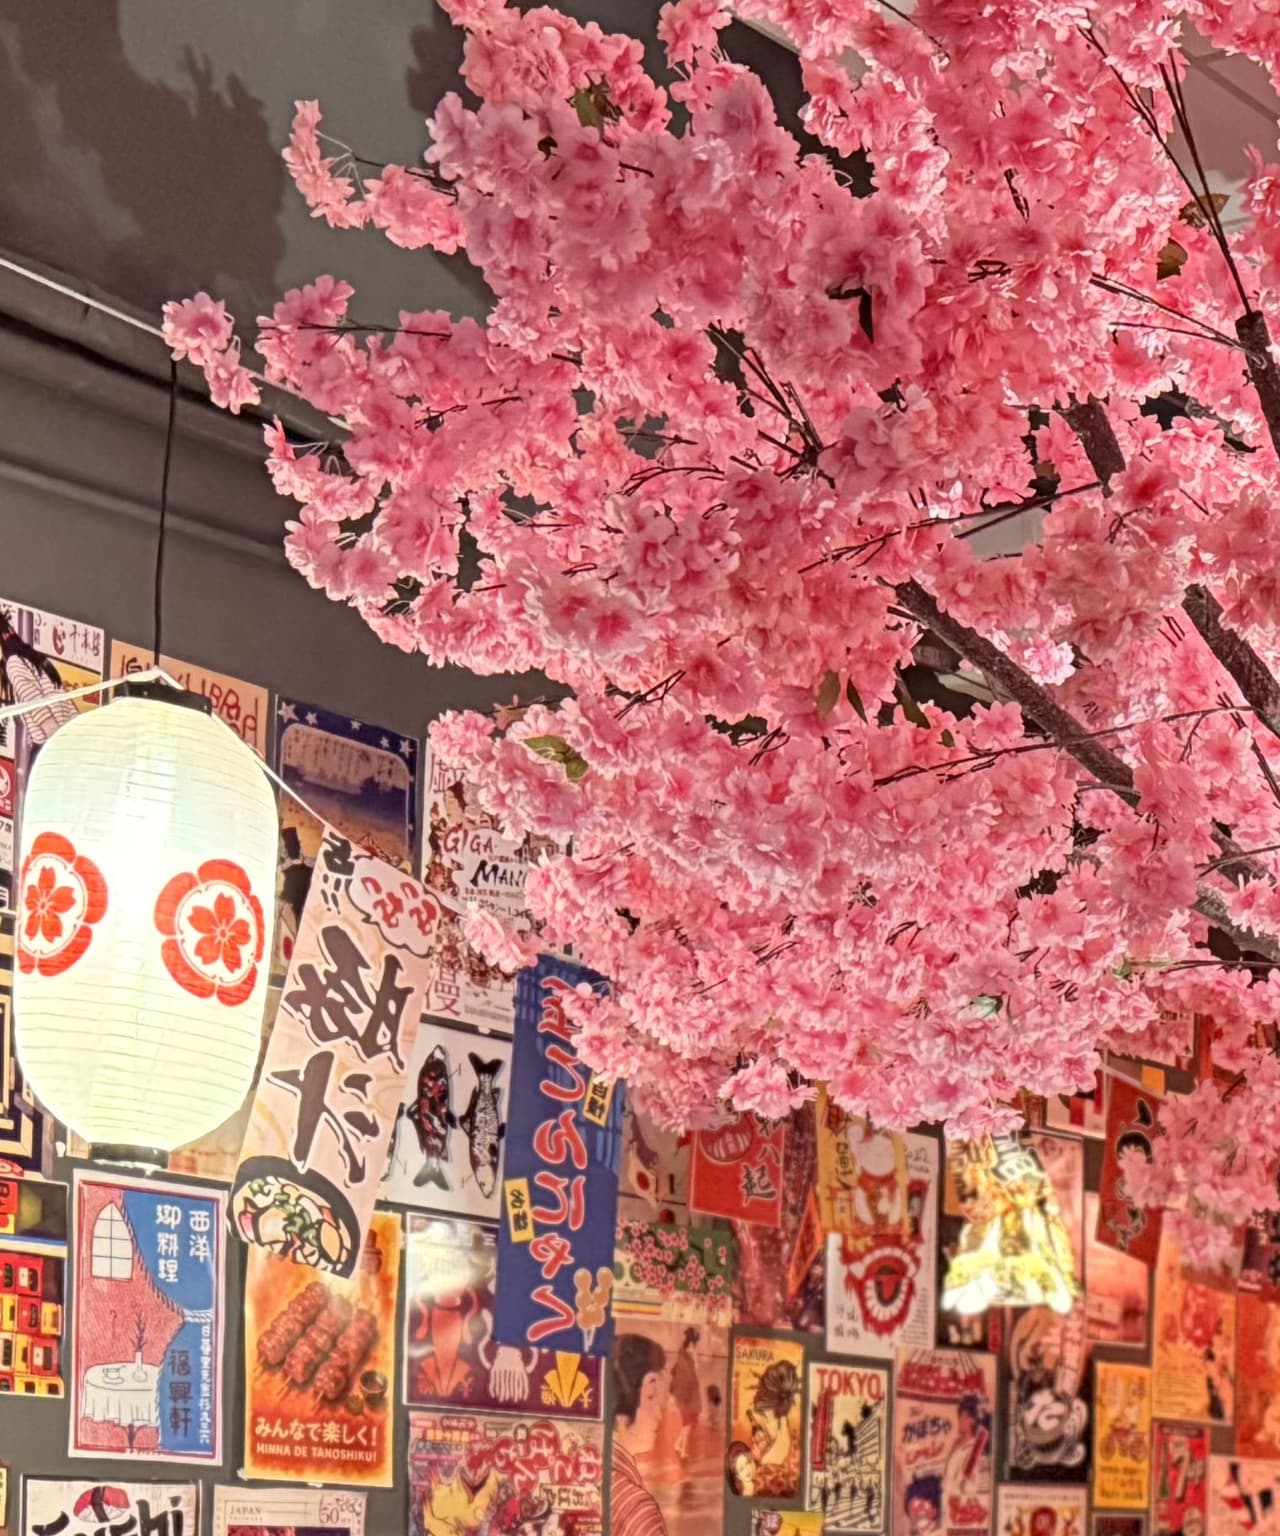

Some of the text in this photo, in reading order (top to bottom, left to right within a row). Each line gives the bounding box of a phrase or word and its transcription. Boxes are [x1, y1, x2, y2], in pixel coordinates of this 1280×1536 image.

[156, 1204, 182, 1283] 御料理
[189, 1210, 211, 1263] 西洋
[816, 1368, 882, 1399] TOKYO
[256, 1443, 291, 1457] MINNA
[294, 1446, 308, 1458] DE
